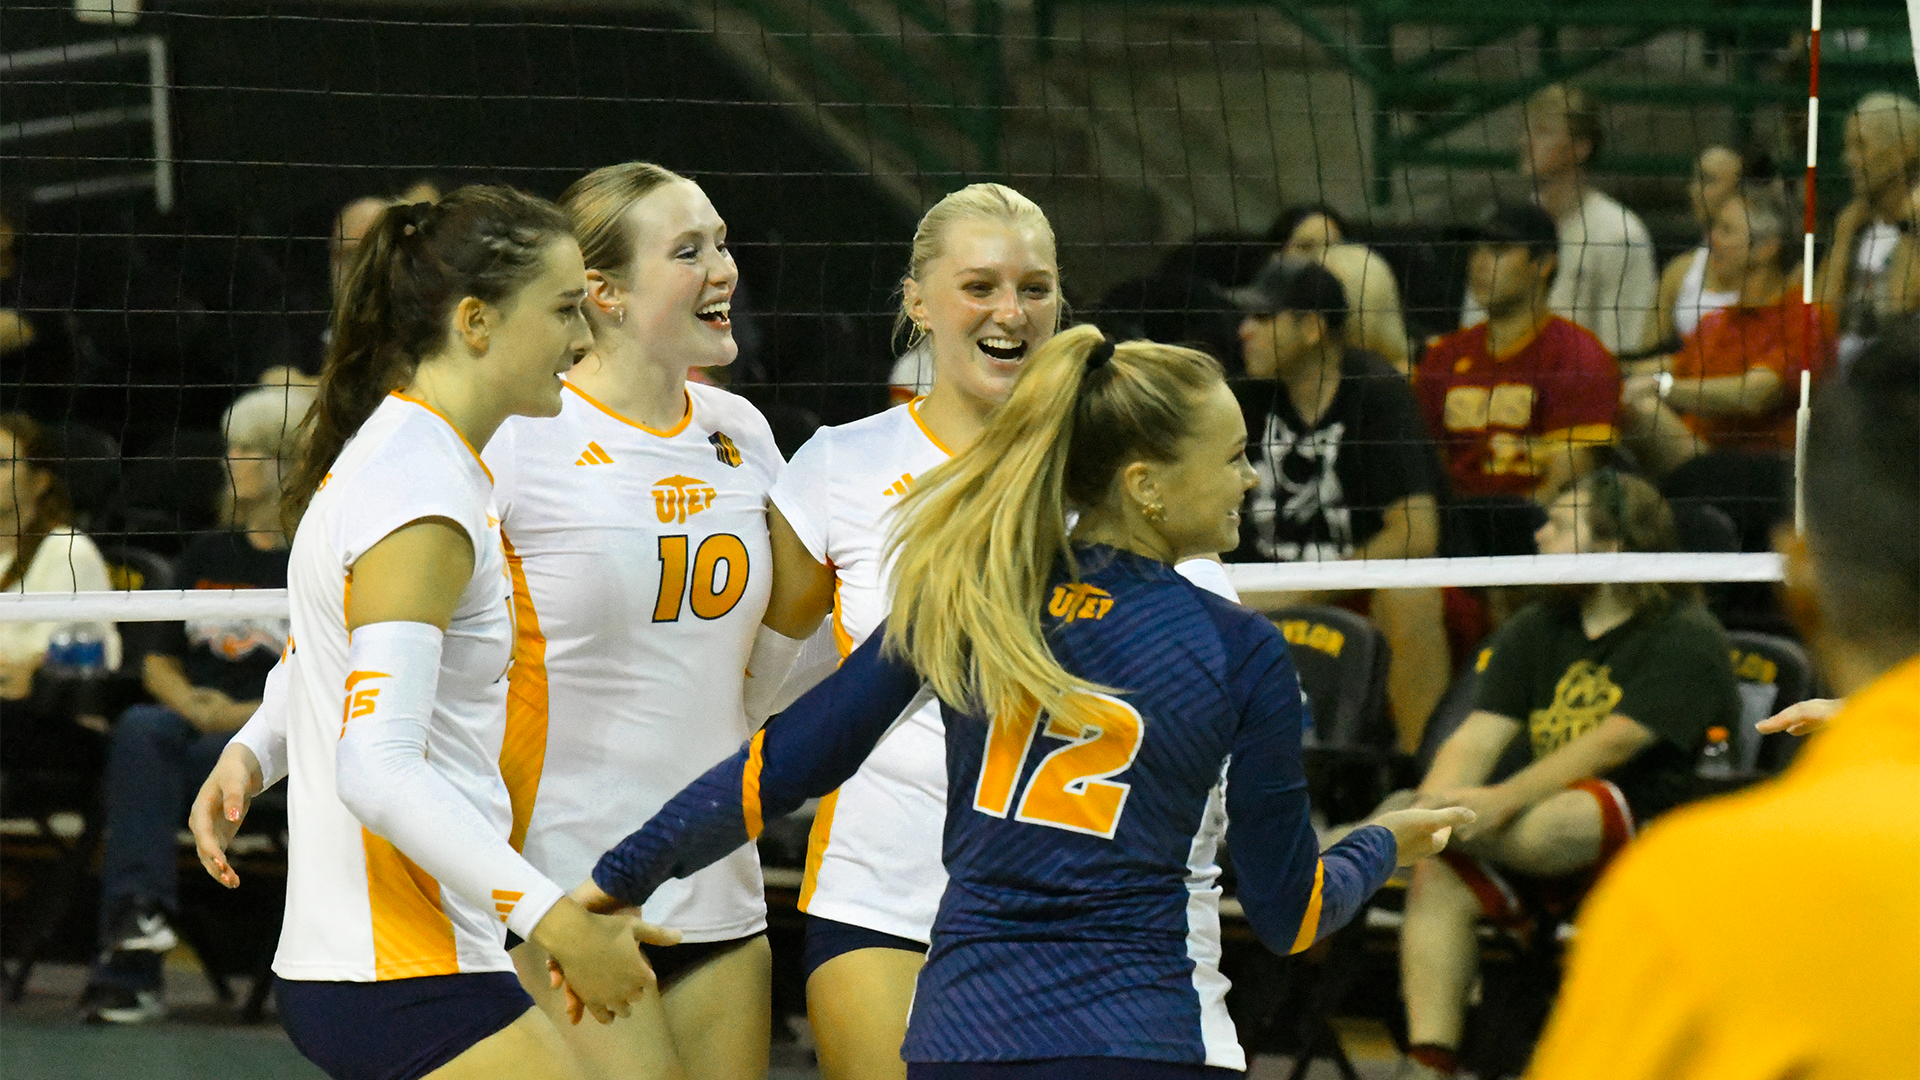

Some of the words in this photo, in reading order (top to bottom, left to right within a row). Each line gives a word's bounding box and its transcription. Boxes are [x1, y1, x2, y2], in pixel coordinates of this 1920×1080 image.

[651, 474, 717, 525] UTEP
[651, 532, 751, 624] 10
[1048, 582, 1115, 624] UTEP
[972, 683, 1146, 841] 12
